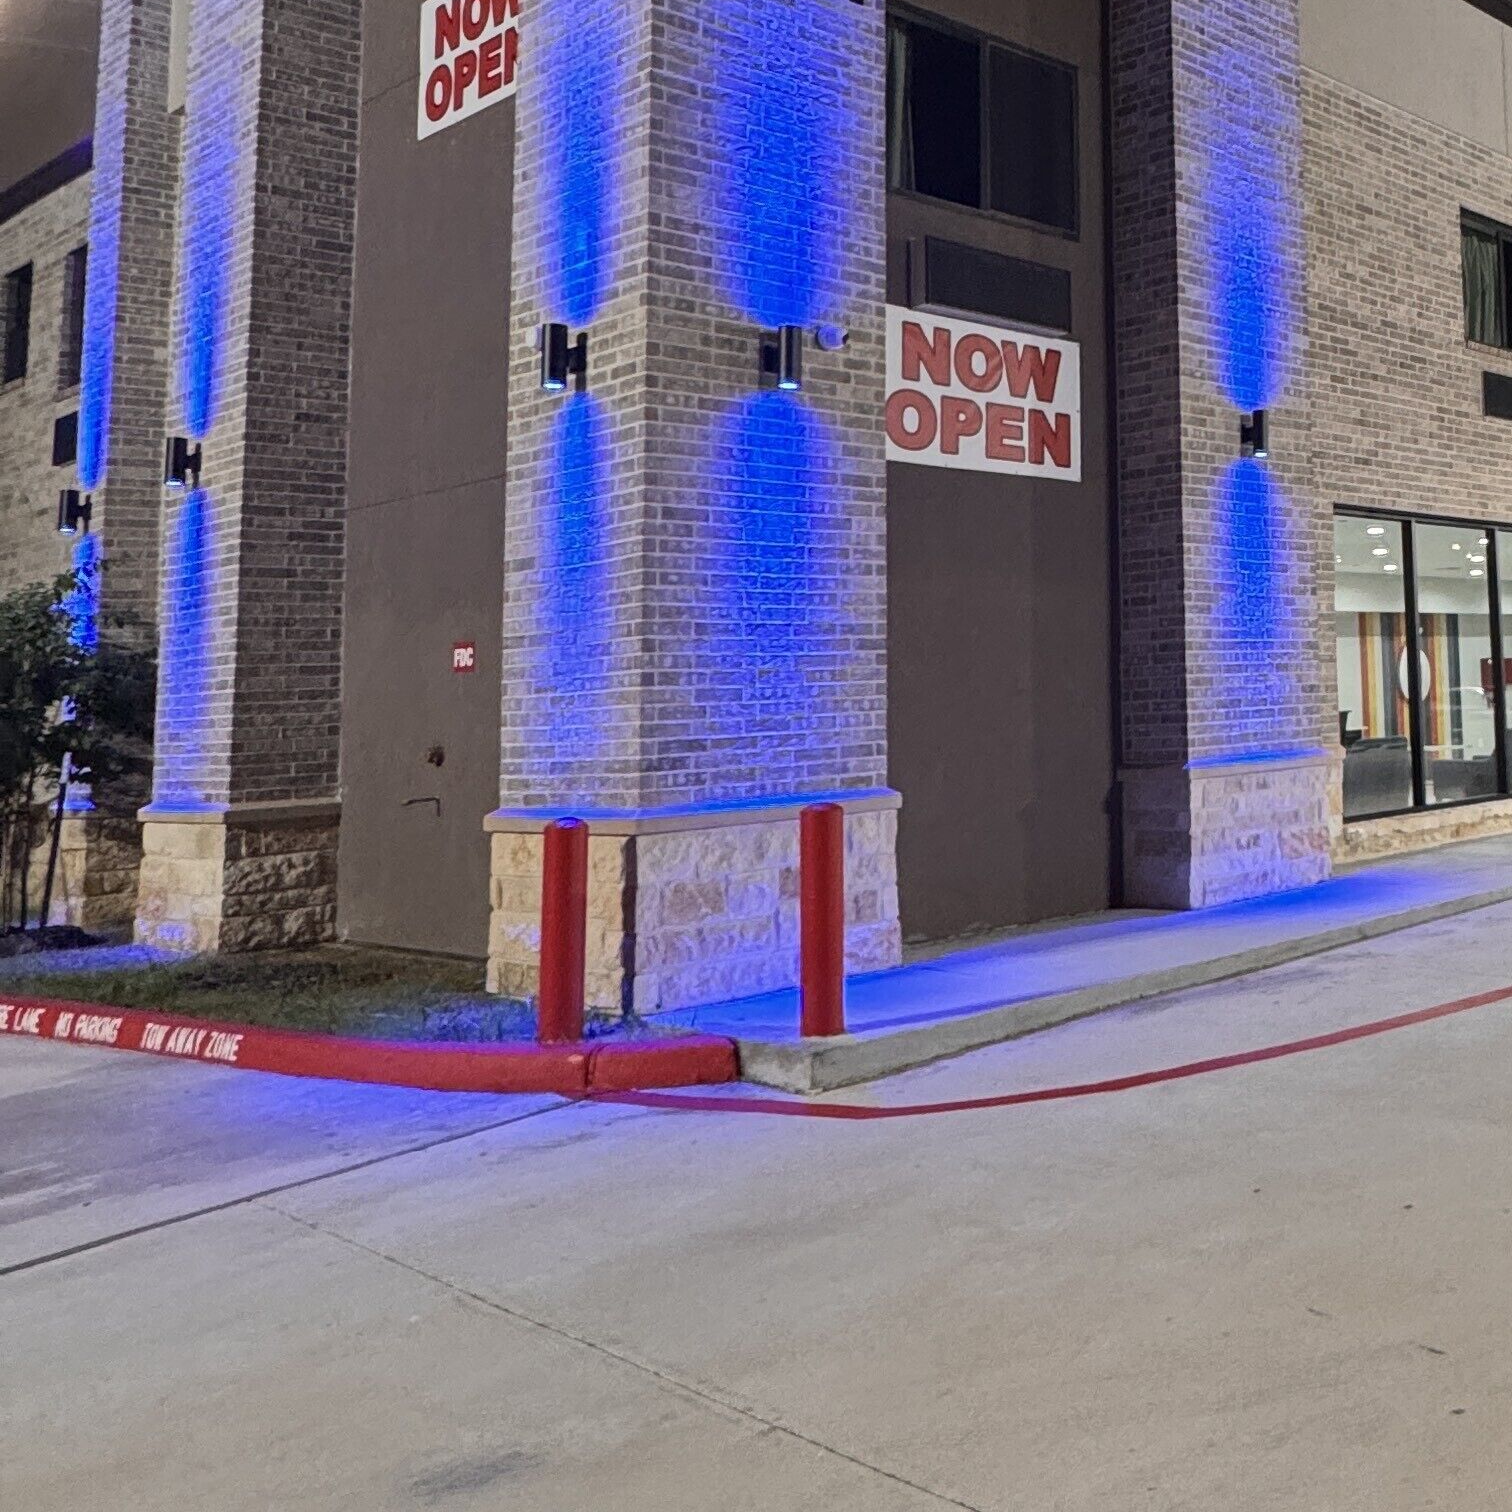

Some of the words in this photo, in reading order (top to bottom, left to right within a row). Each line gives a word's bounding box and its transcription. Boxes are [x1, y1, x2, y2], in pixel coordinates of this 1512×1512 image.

[902, 322, 1061, 402] NOW
[886, 389, 1071, 468] OPEN
[453, 647, 474, 668] FDC
[54, 1011, 75, 1037] NO
[140, 1022, 171, 1050] TOW
[165, 1027, 207, 1055] AWAY
[204, 1031, 243, 1061] ZONE
